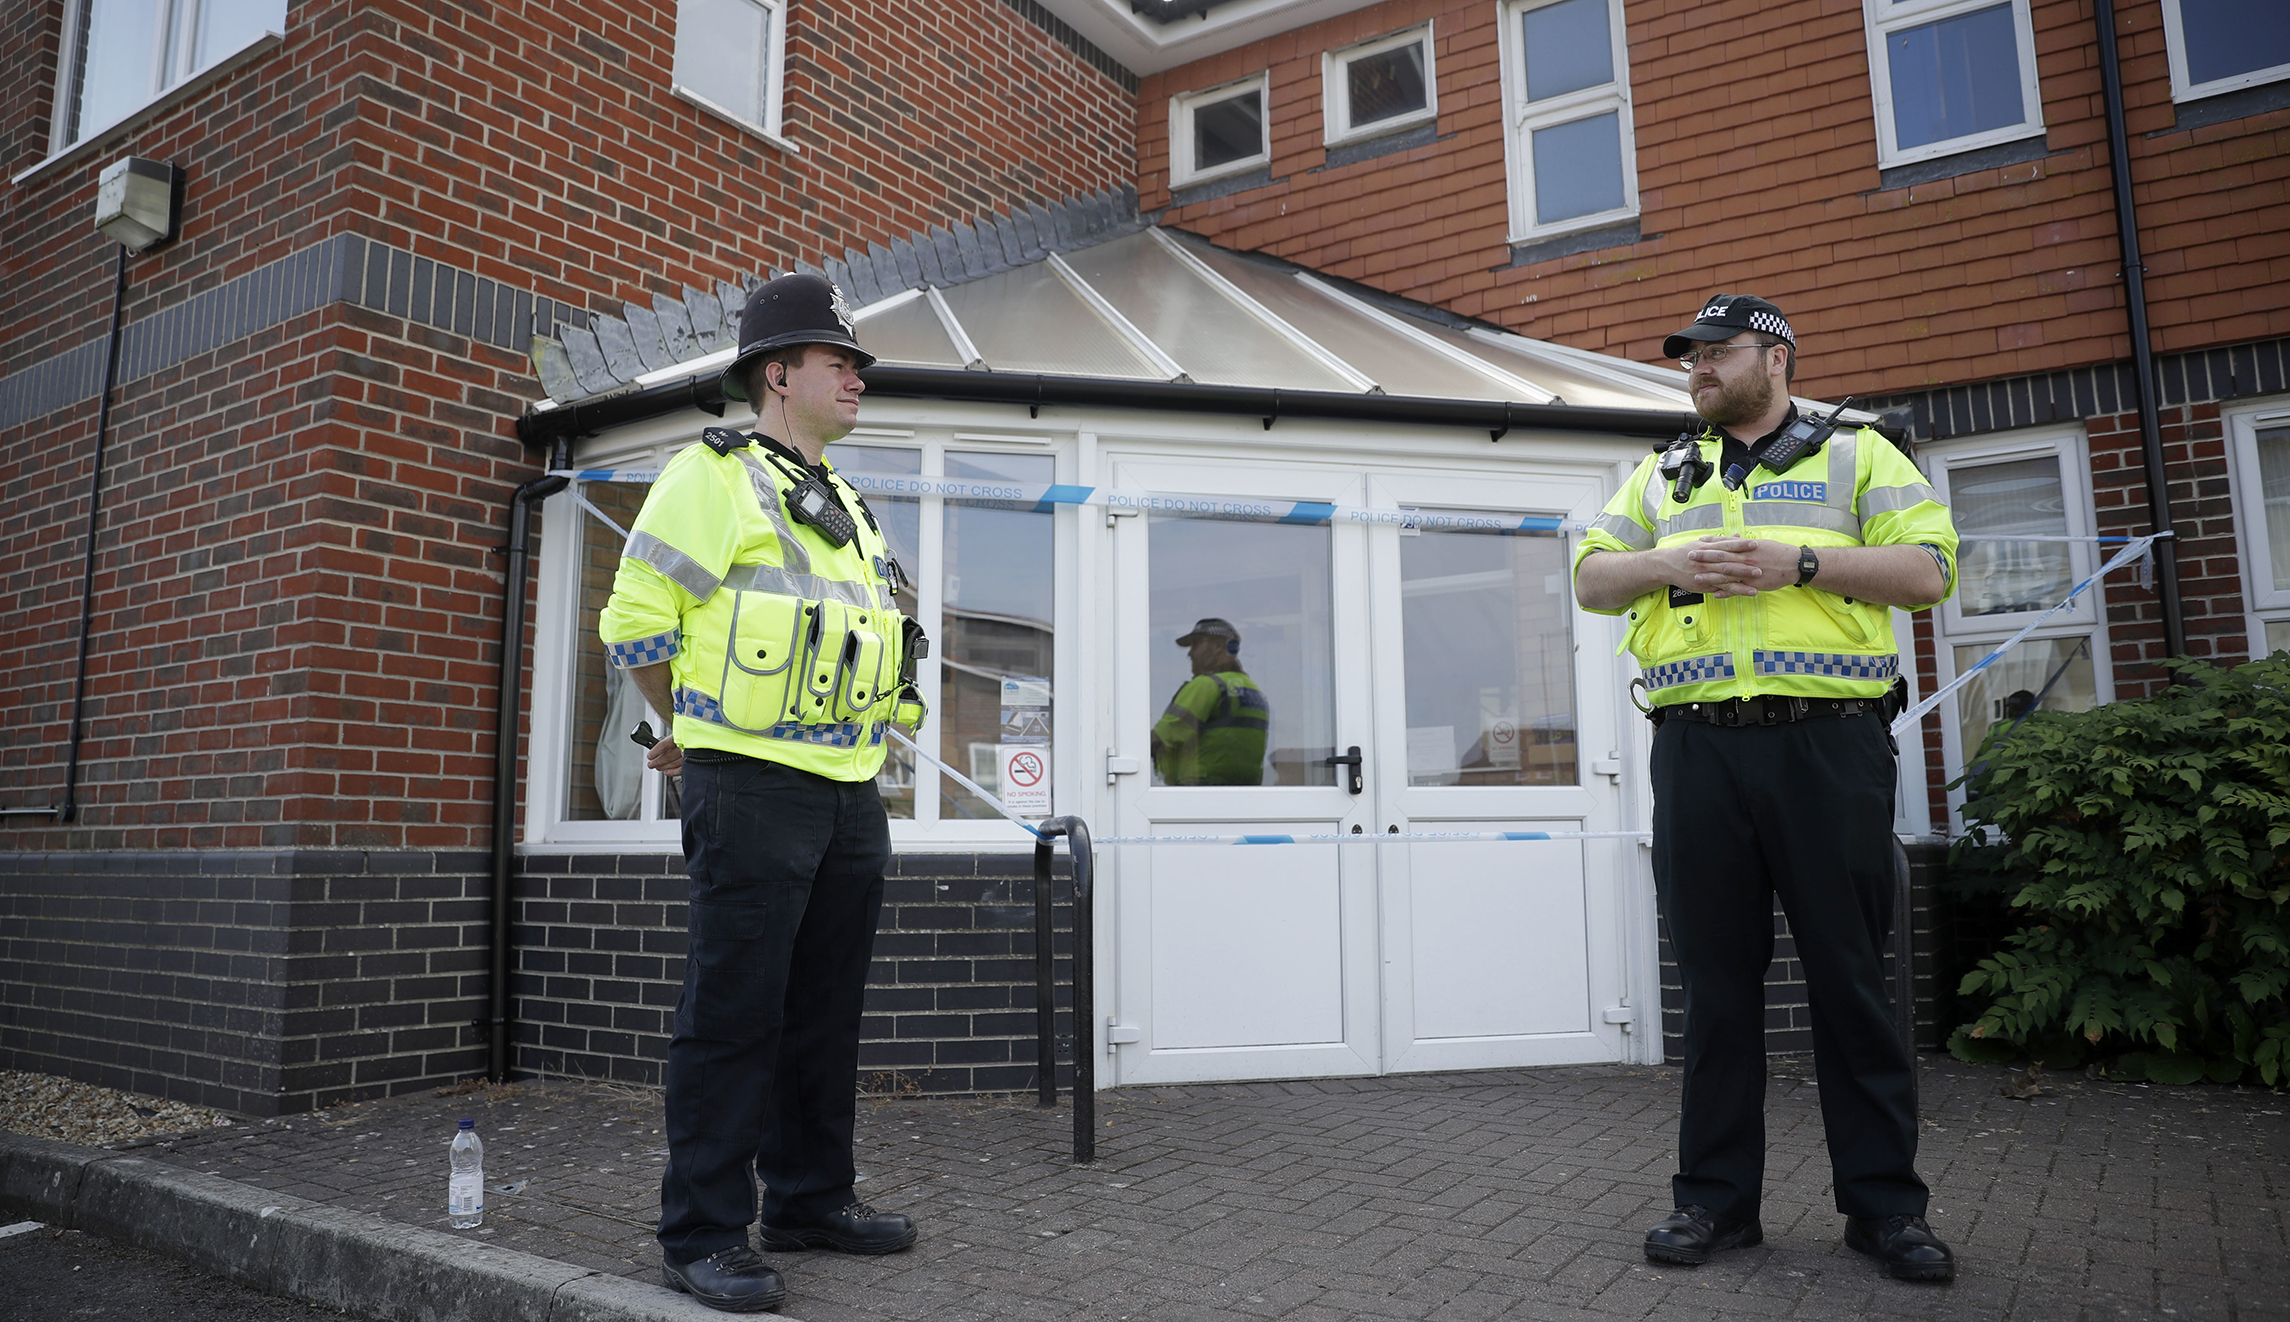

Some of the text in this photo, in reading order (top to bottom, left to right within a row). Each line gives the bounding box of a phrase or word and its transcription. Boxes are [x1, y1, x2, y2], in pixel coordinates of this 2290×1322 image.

[1694, 305, 1729, 322] LICE
[704, 431, 725, 448] 2501
[626, 472, 661, 484] POLIC
[851, 476, 1023, 499] POLICE DO NOT CROSS
[1757, 483, 1823, 499] POLICE
[1108, 495, 1160, 509] POLICE
[1164, 499, 1185, 511] DO
[1189, 501, 1219, 513] NOT
[1222, 503, 1272, 516] CROSS
[1350, 511, 1399, 523] POLICE
[1402, 514, 1423, 526] DO
[1425, 515, 1453, 527] NOT
[1457, 517, 1503, 529] CROSS
